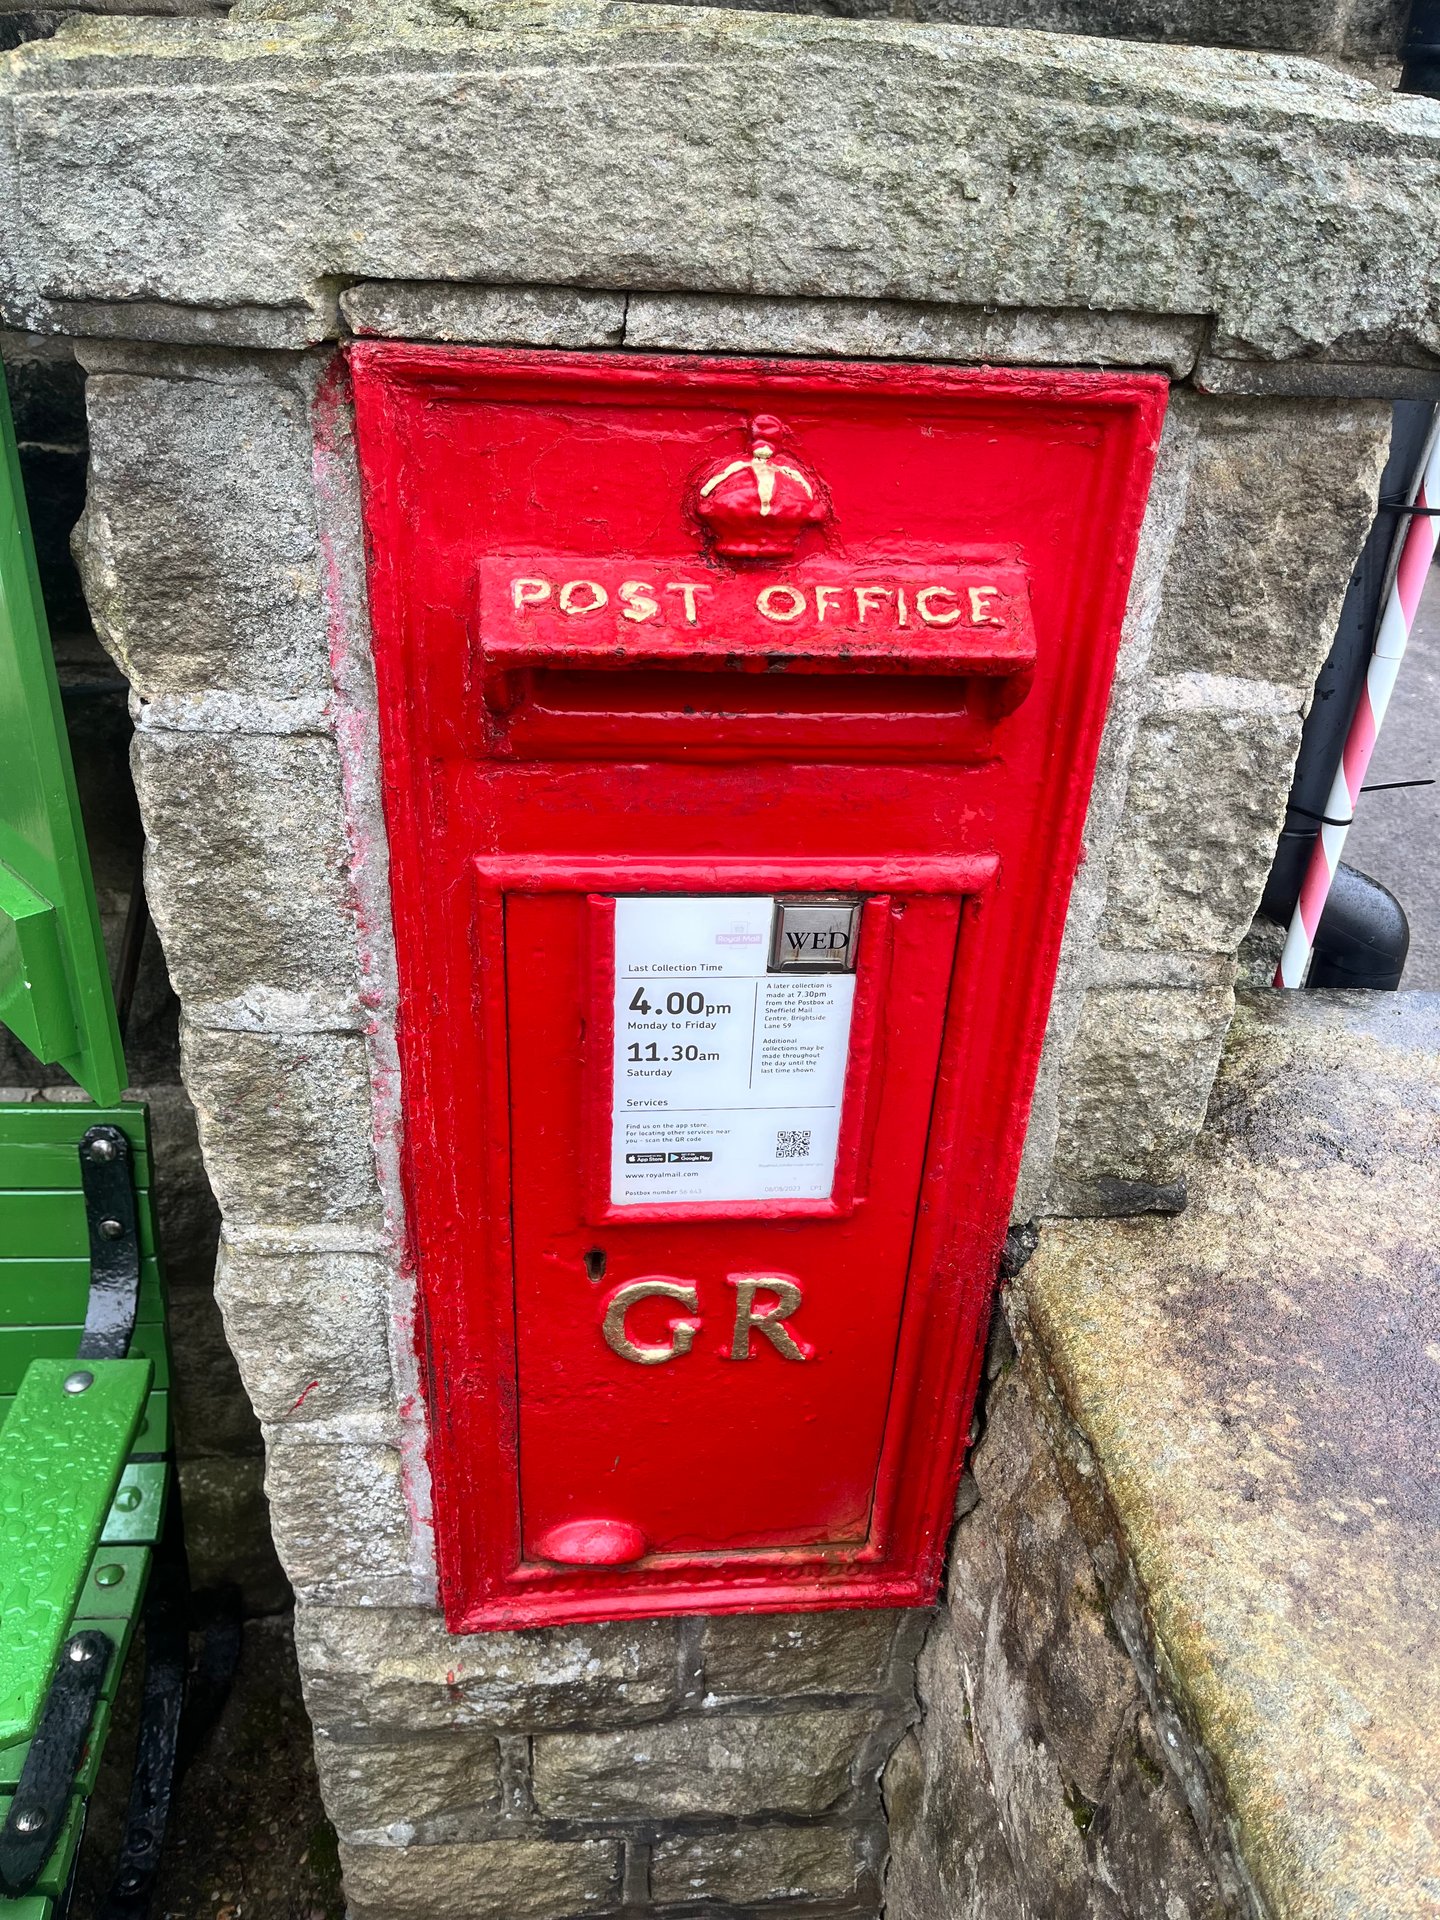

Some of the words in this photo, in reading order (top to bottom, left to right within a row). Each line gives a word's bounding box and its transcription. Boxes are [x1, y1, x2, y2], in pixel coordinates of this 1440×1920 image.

[511, 578, 709, 625] POST
[756, 585, 1004, 629] OFFICE
[785, 931, 849, 950] WED
[628, 964, 649, 972] Last
[651, 963, 697, 972] Collection
[700, 963, 723, 972] Time
[628, 986, 731, 1017] 4.00pm
[627, 1021, 668, 1030] Monday
[671, 1021, 681, 1029] to
[685, 1020, 717, 1030] Friday
[627, 1042, 720, 1062] 11.30am
[627, 1068, 673, 1077] Saturday
[626, 1099, 669, 1107] Services
